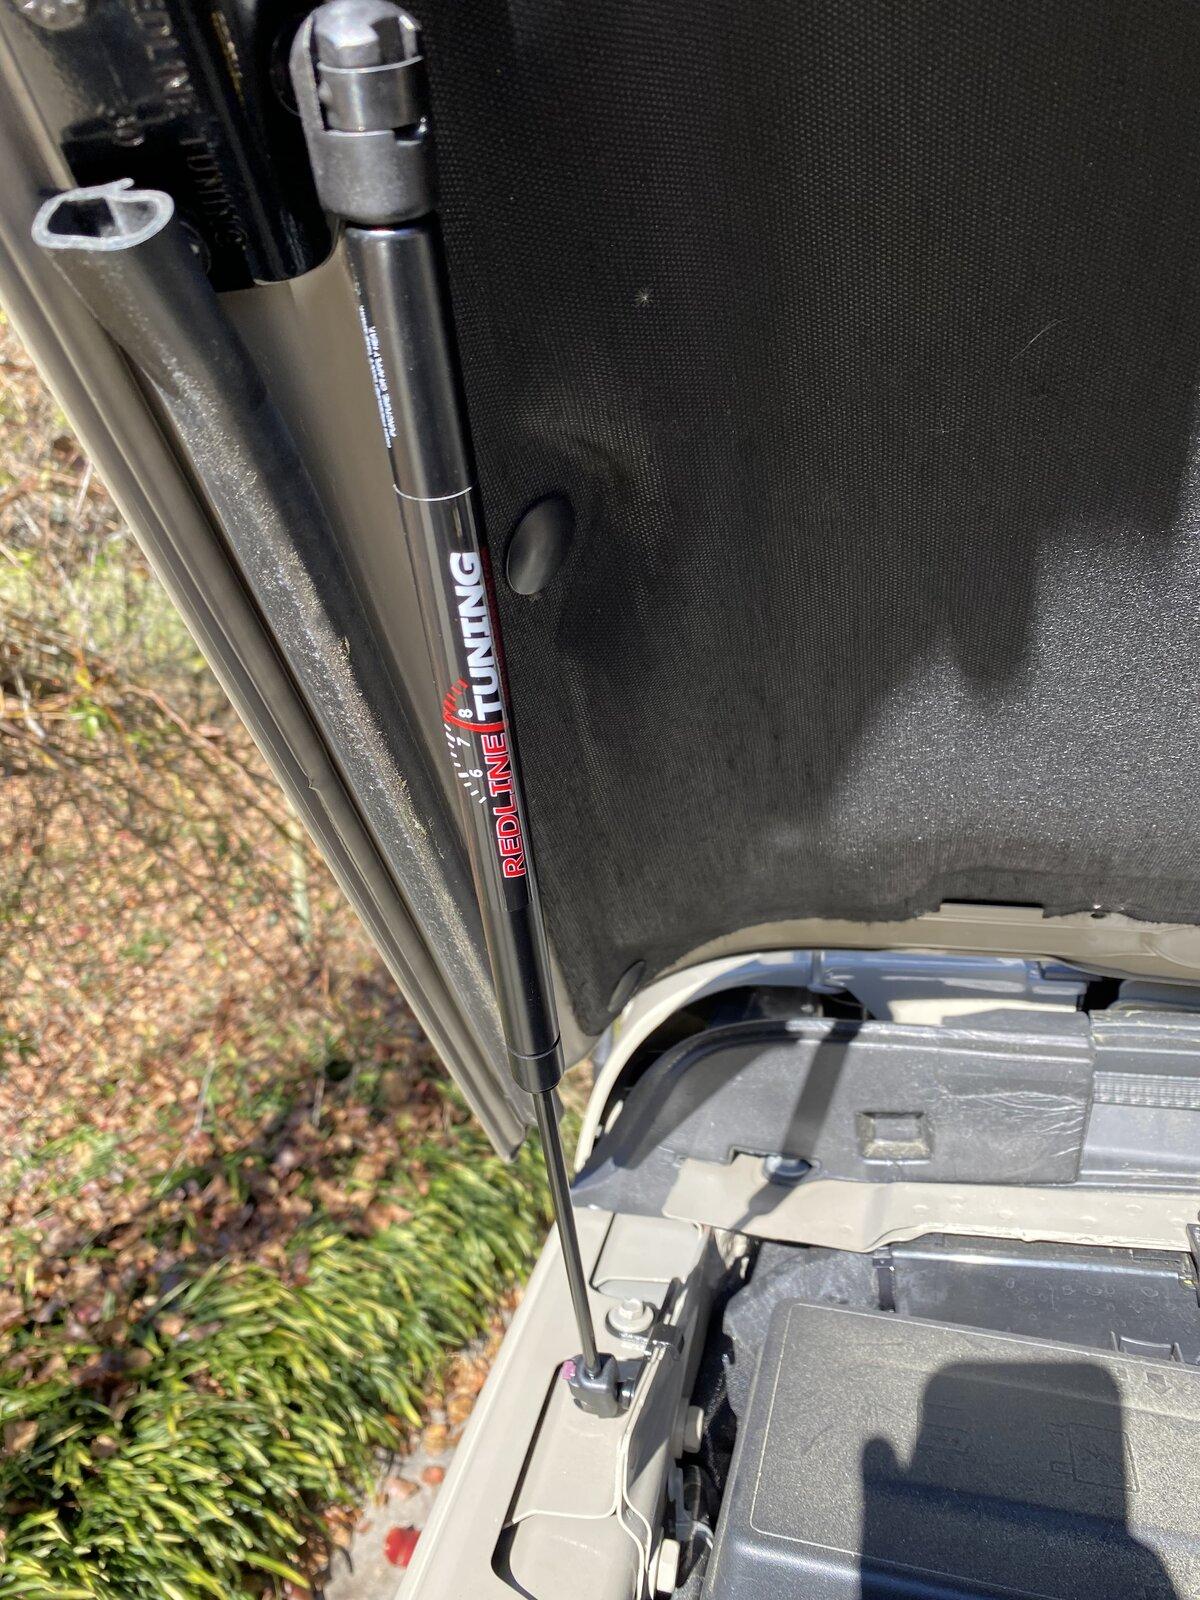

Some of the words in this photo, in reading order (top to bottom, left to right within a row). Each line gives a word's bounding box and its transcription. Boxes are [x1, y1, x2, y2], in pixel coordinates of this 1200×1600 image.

[450, 552, 502, 721] TUNING
[457, 707, 474, 720] 8
[457, 736, 472, 748] 7
[468, 768, 484, 780] 6
[481, 733, 527, 879] REDLINE
